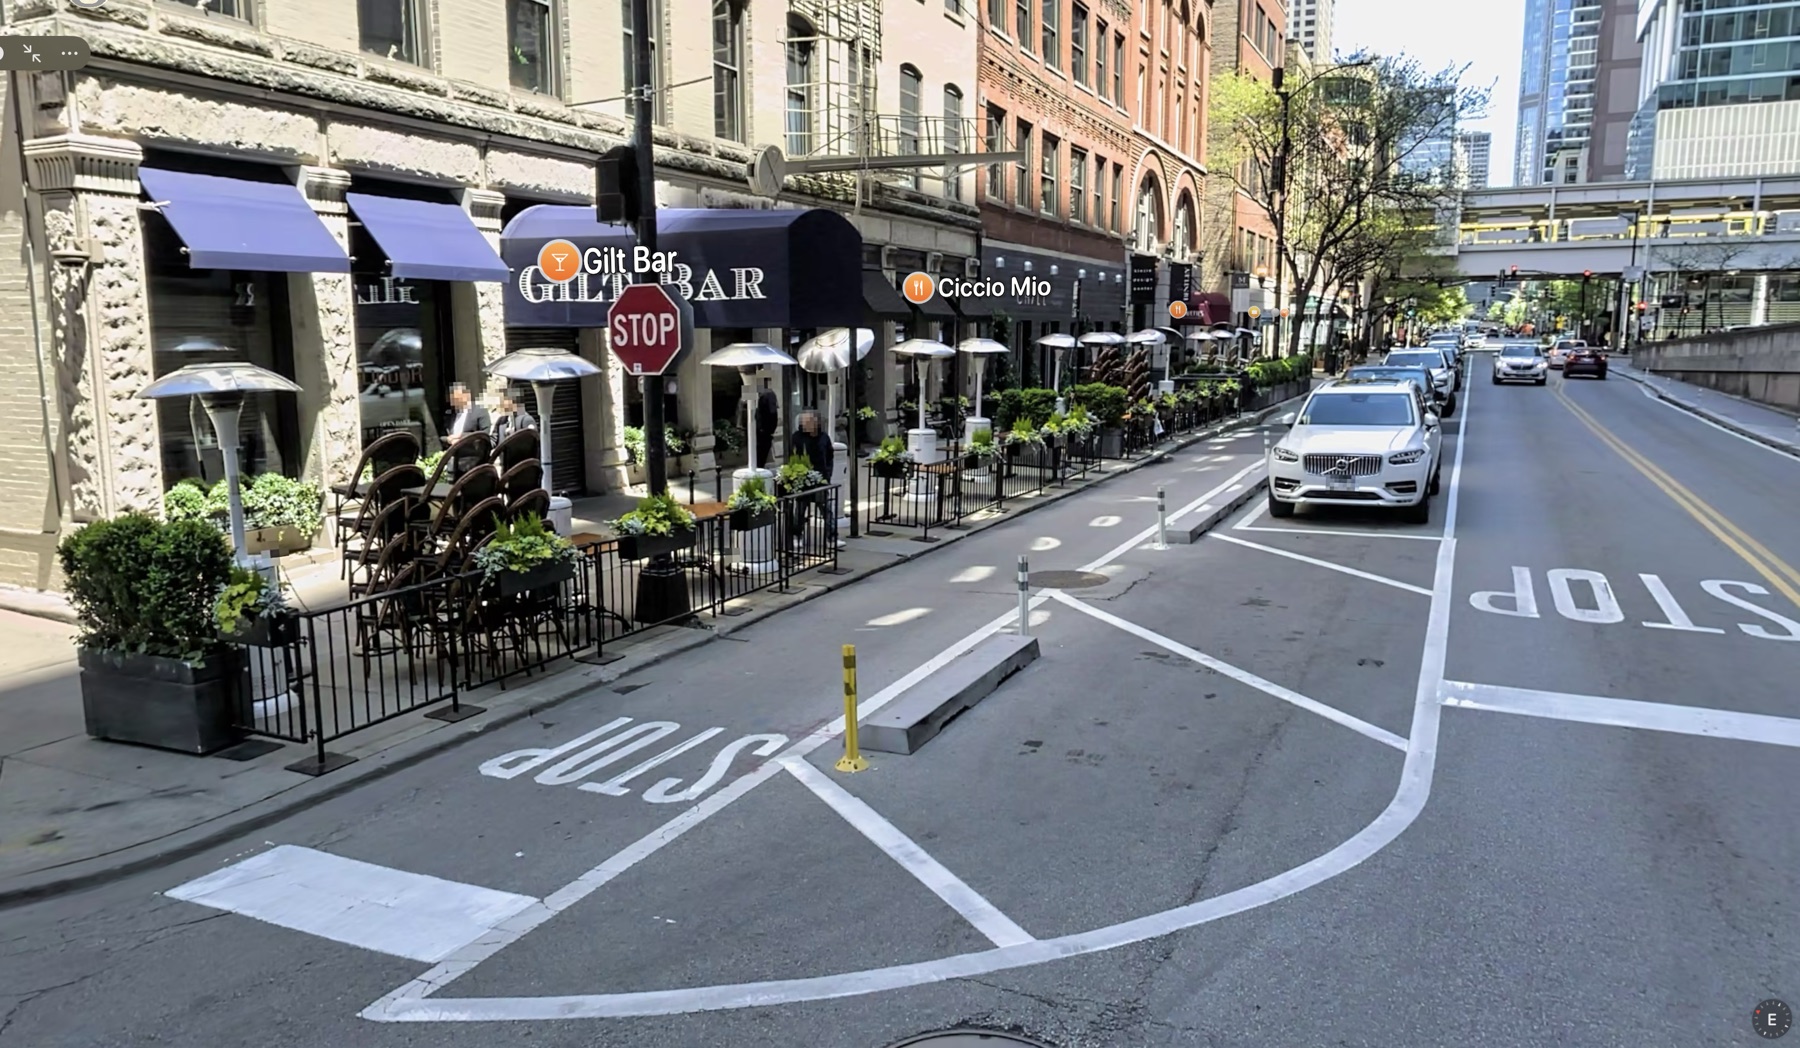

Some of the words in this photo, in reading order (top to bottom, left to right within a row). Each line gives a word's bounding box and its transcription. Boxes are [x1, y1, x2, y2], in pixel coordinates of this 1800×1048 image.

[613, 312, 676, 347] STOP
[1469, 565, 1800, 641] STOP
[478, 716, 790, 803] STOP
